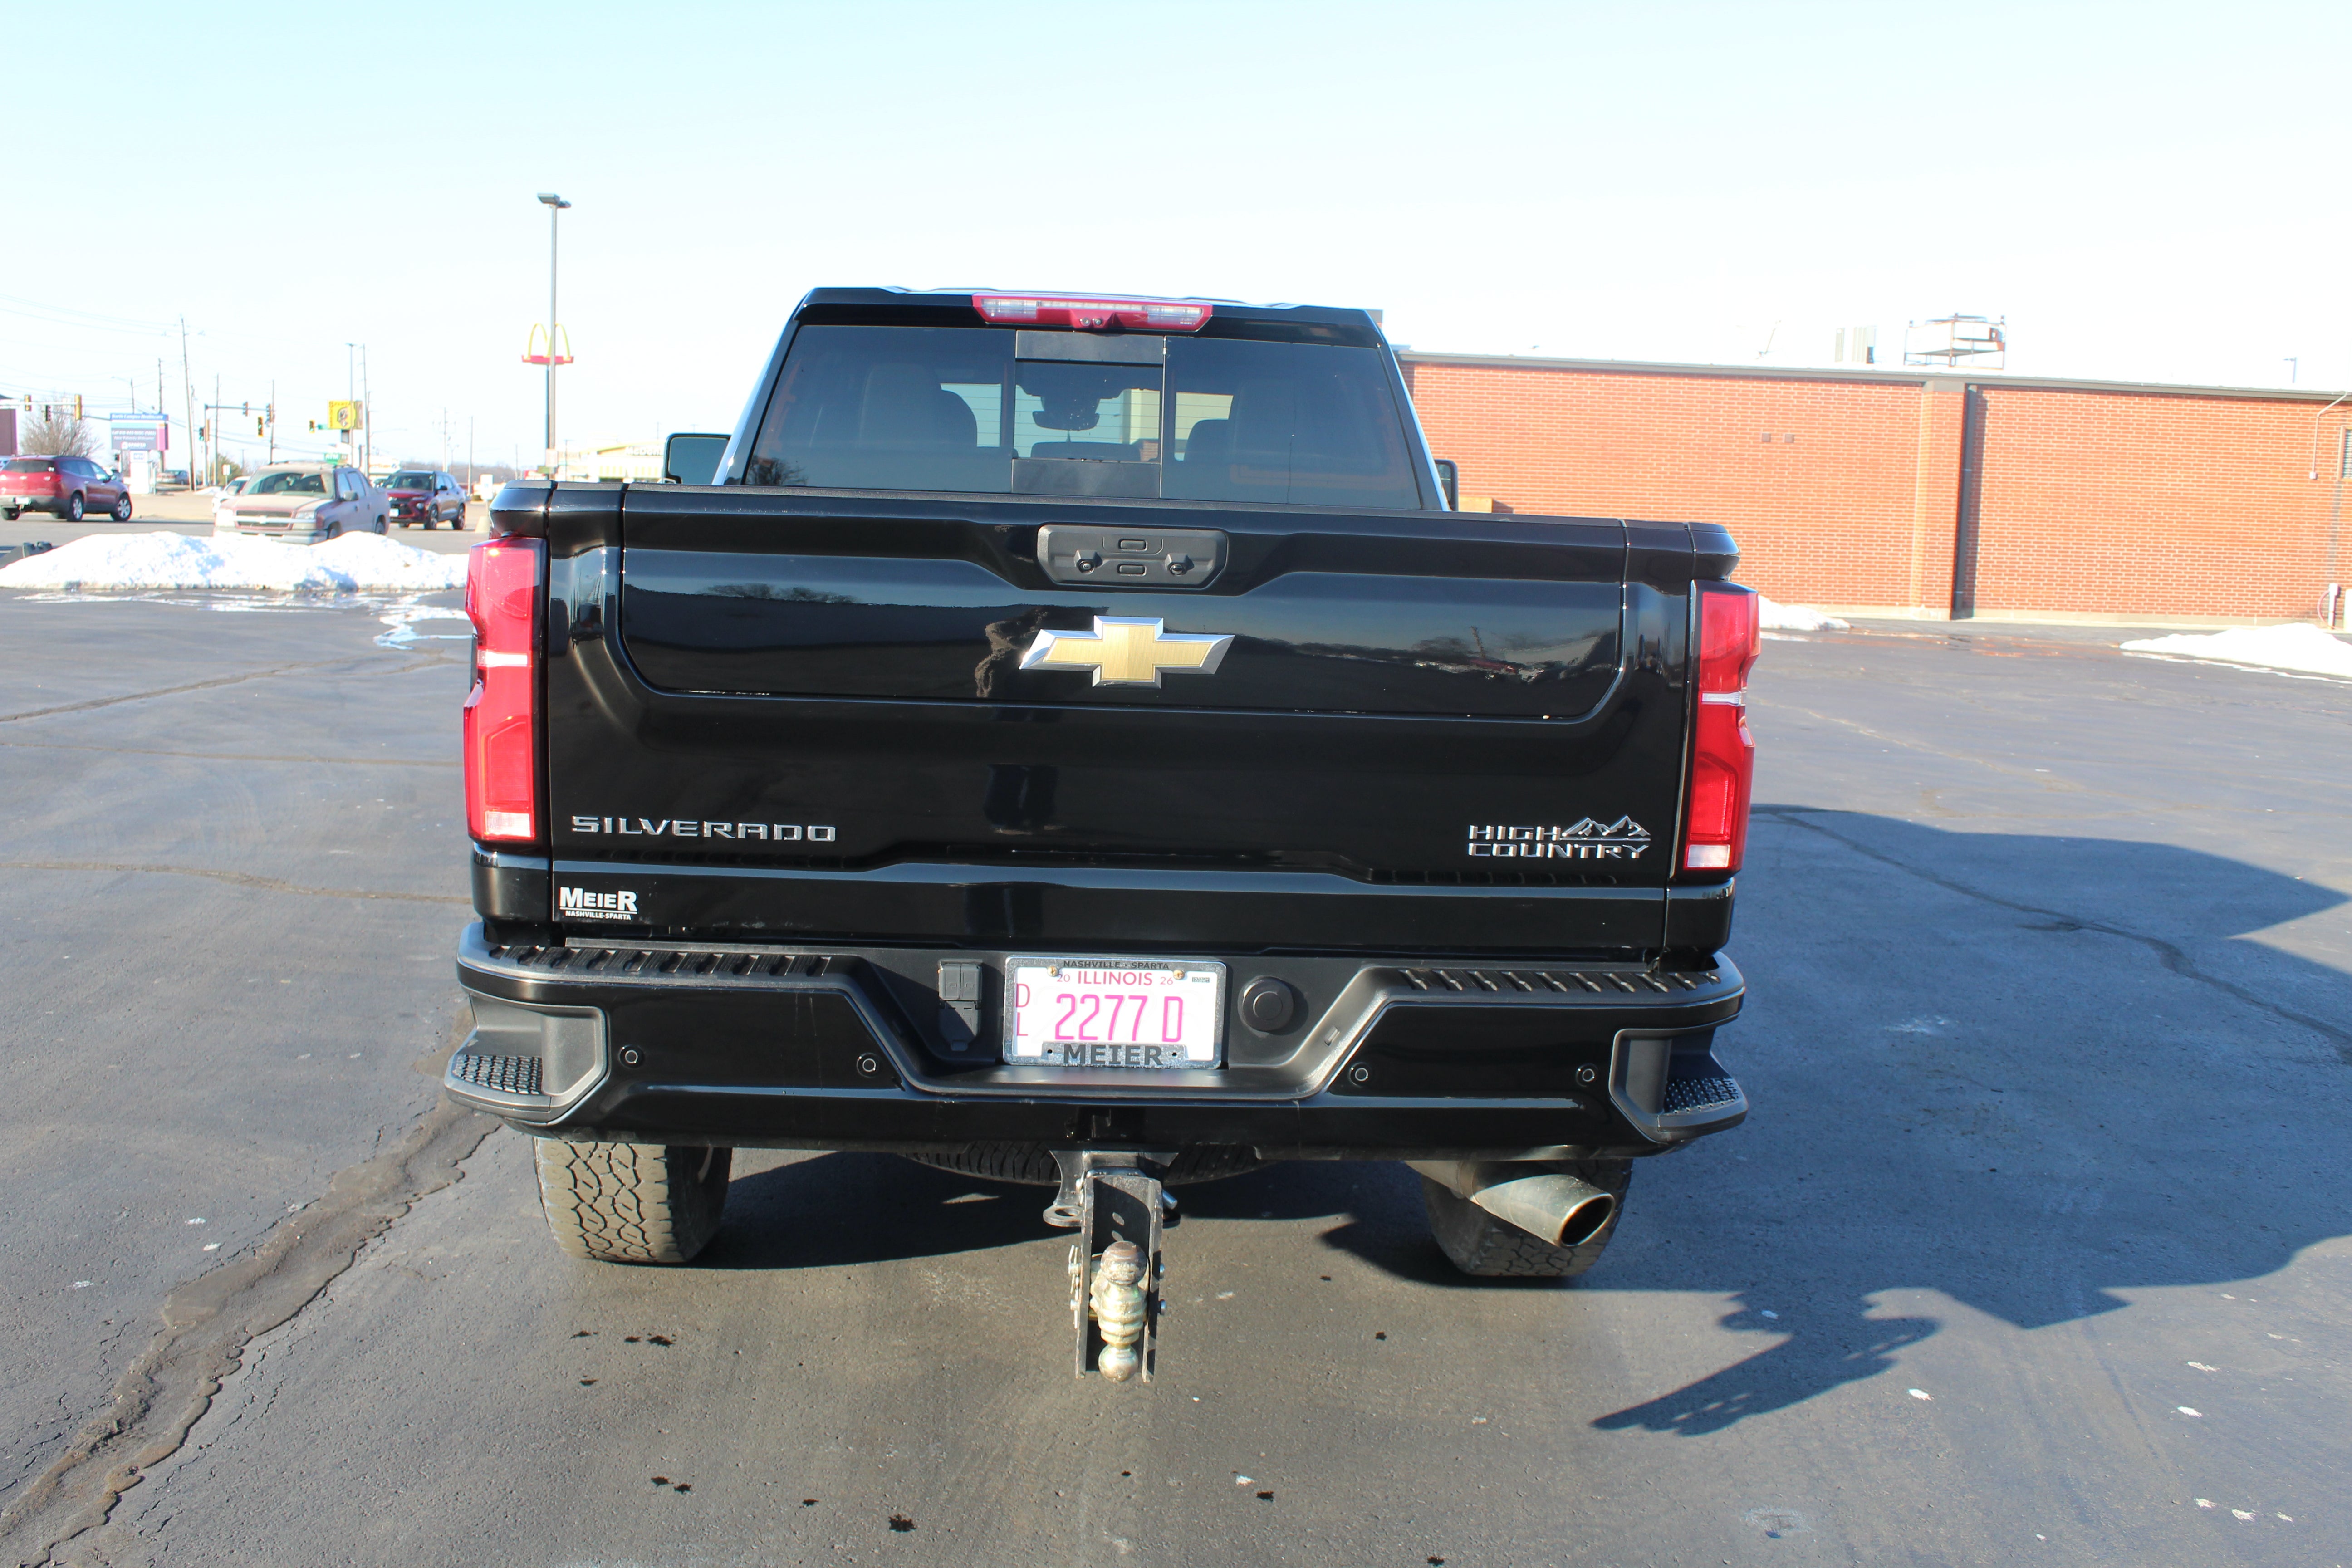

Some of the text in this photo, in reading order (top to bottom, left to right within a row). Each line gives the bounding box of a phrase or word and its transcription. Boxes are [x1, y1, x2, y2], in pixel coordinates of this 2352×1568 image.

[572, 815, 836, 842] SILVERADO
[1469, 825, 1561, 841] HIGH
[1468, 843, 1649, 859] COUNTRY
[1057, 971, 1173, 985] 20 ILLINOIS 26
[1055, 993, 1148, 1041] 2277
[1063, 1044, 1163, 1066] MEIER
